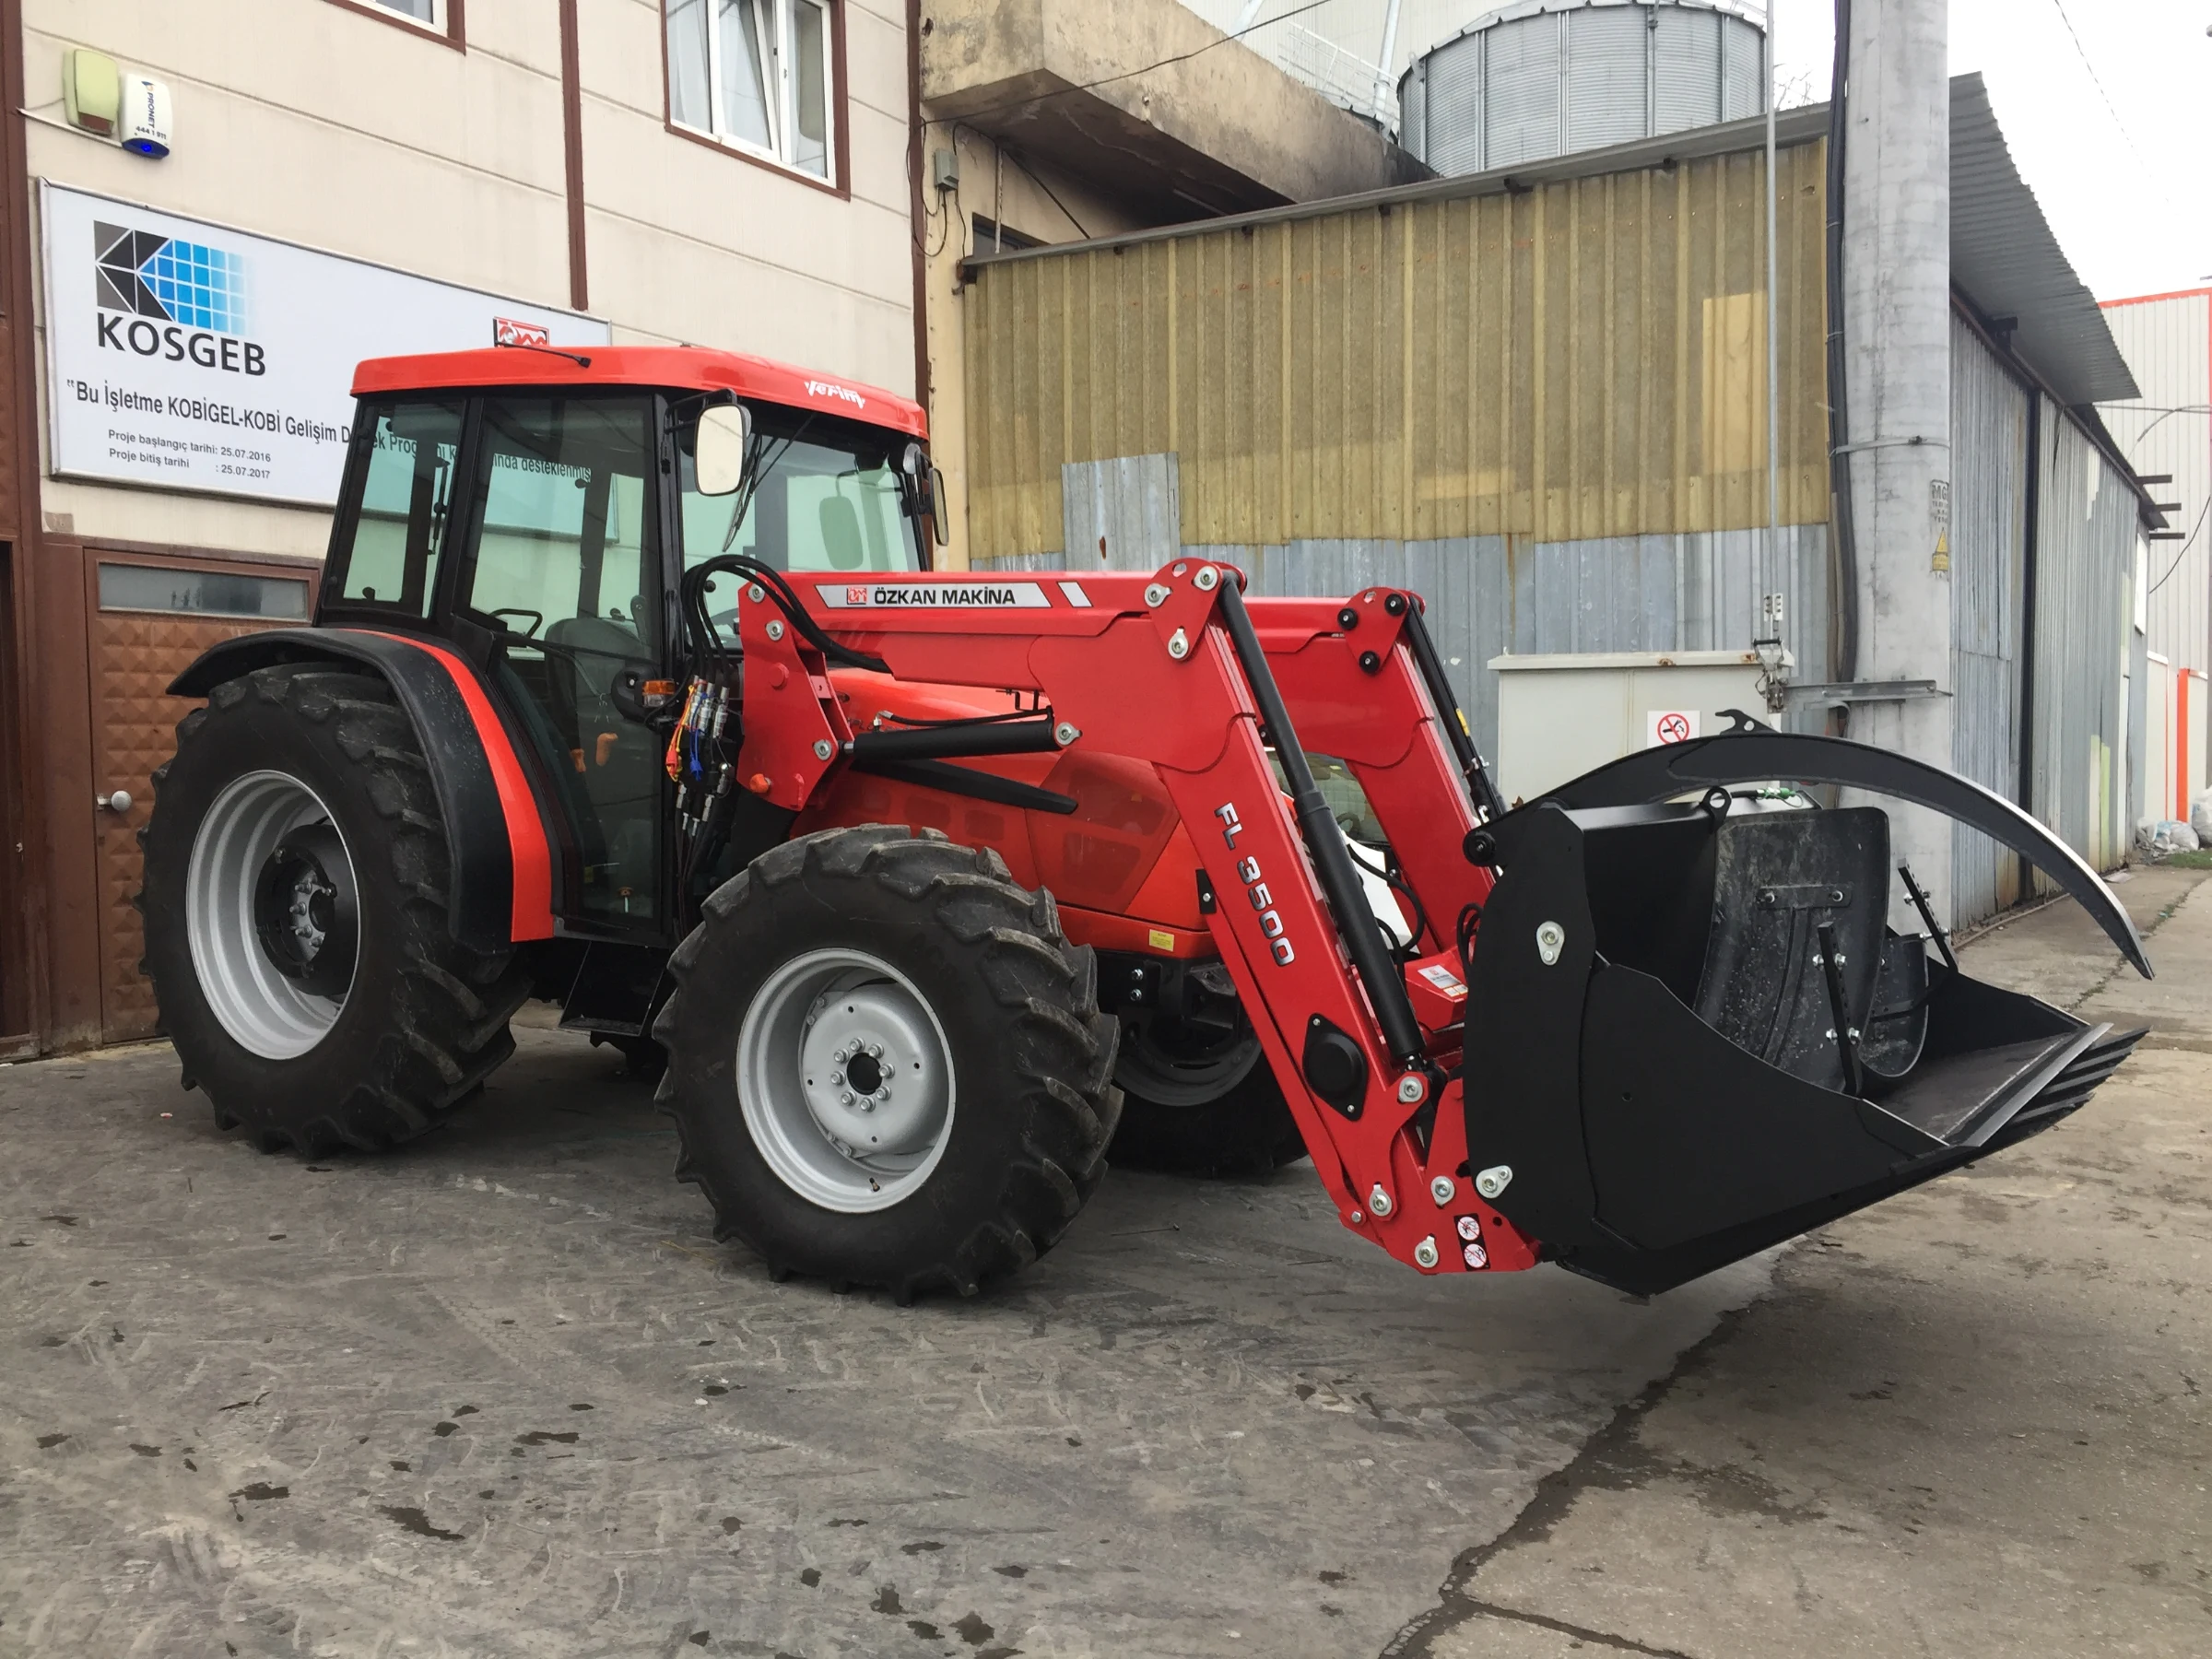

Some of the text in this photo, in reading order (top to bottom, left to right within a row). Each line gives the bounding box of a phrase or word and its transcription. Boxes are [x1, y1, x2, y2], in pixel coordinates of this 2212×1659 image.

[135, 125, 150, 135] 444
[156, 131, 167, 140] 911
[97, 312, 266, 377] KOSGEB
[104, 380, 163, 413] İşletme
[168, 396, 281, 433] KOBİGEL-KOBİ
[285, 416, 337, 444] Gelişim
[108, 429, 272, 463] Proje başlangıç tarihi: 25.07.2016
[109, 447, 137, 464] Proje
[139, 452, 161, 467] bitiş
[164, 455, 190, 468] tarihi
[220, 464, 271, 480] 25.07.2017
[874, 585, 936, 606] ÖZKAN
[942, 585, 1016, 606] MAKİNA
[1214, 800, 1296, 968] FL 3500
